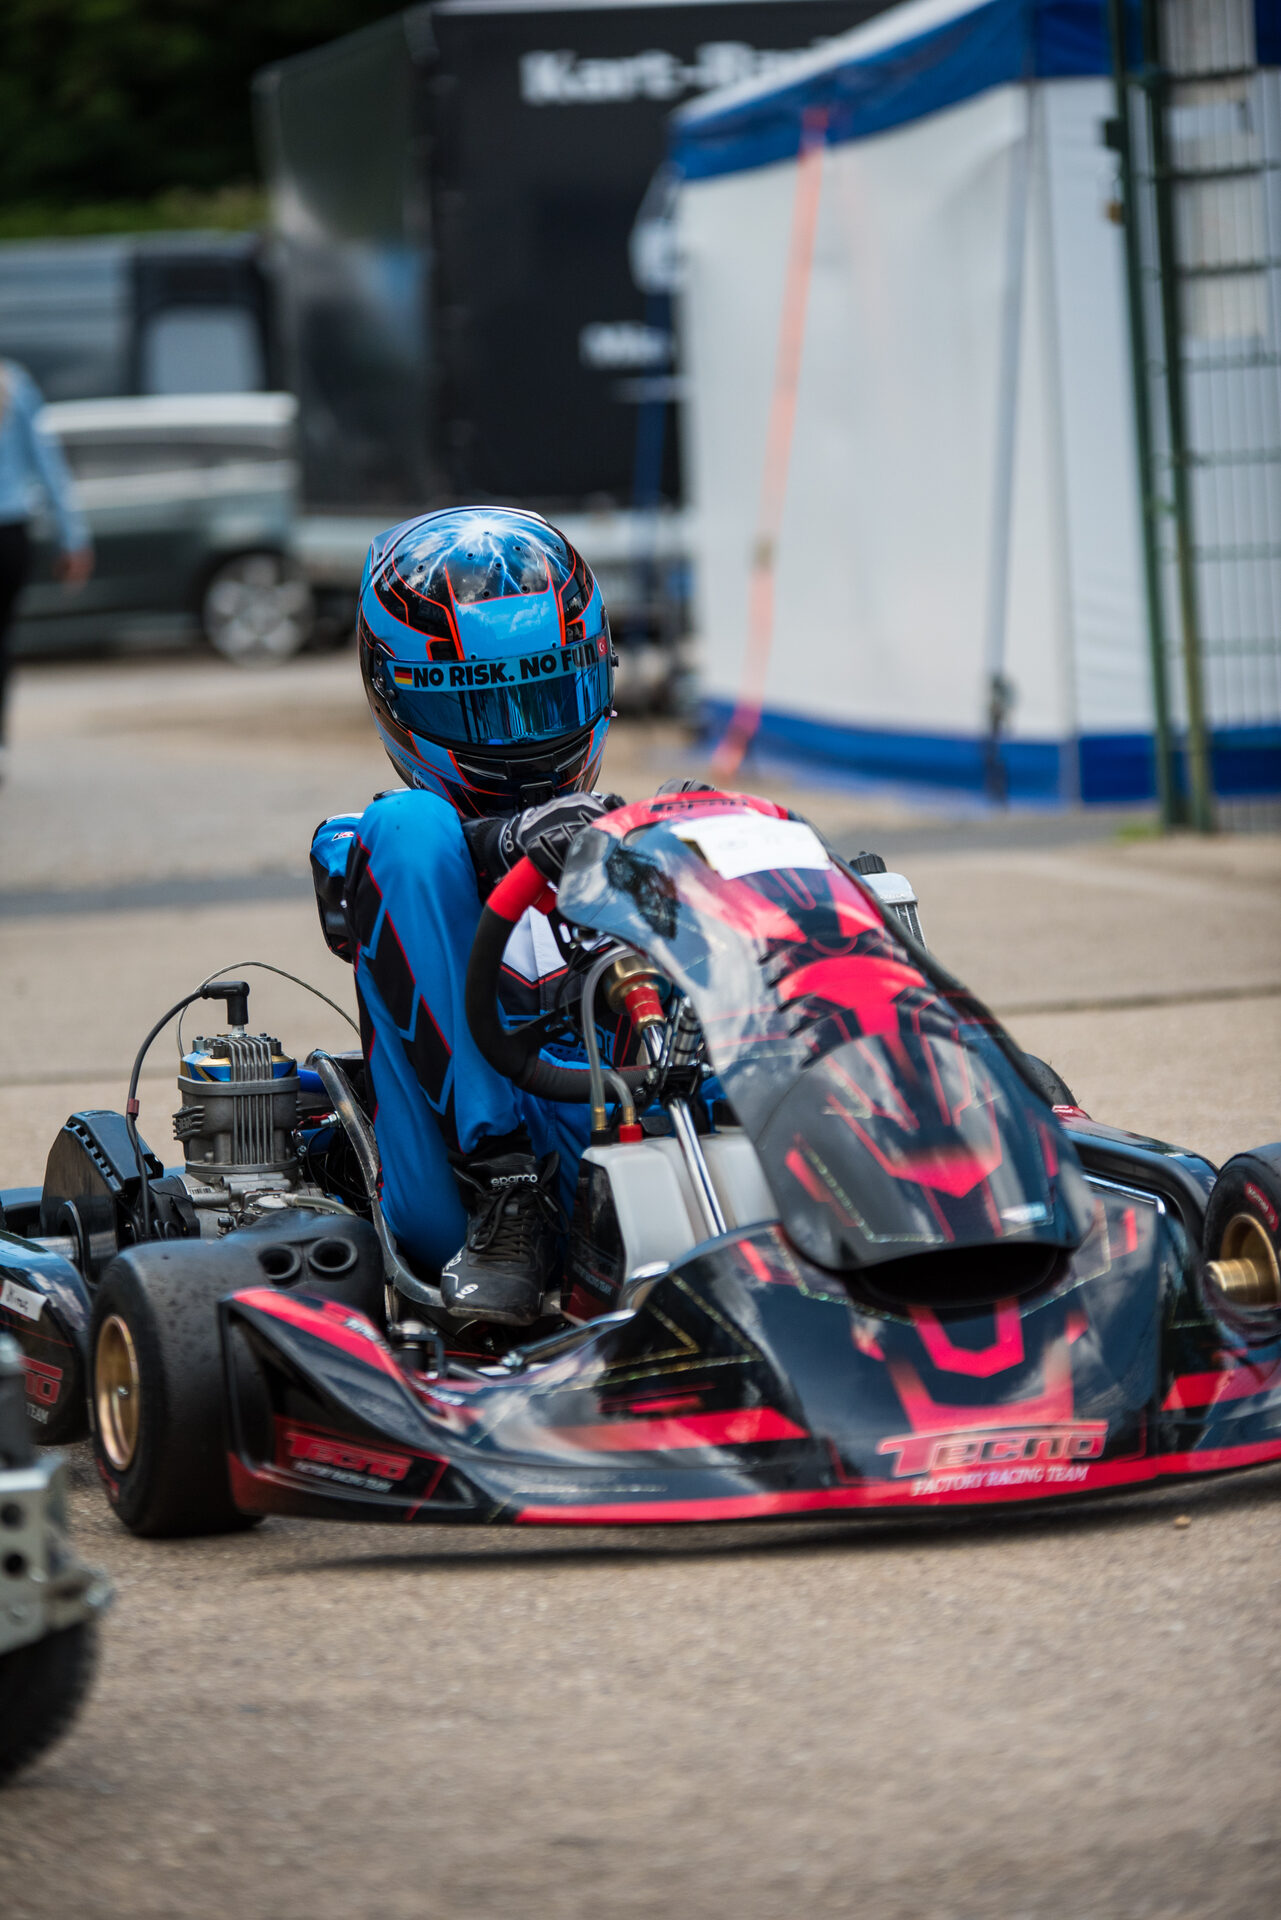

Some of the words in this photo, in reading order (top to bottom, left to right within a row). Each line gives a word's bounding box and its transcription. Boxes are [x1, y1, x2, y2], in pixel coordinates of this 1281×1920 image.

[413, 667, 444, 688] NO
[450, 663, 515, 687] RISK.
[519, 655, 557, 680] NO
[912, 1474, 985, 1496] FACTORY
[986, 1468, 1043, 1486] RACING
[1046, 1464, 1090, 1483] TEAM
